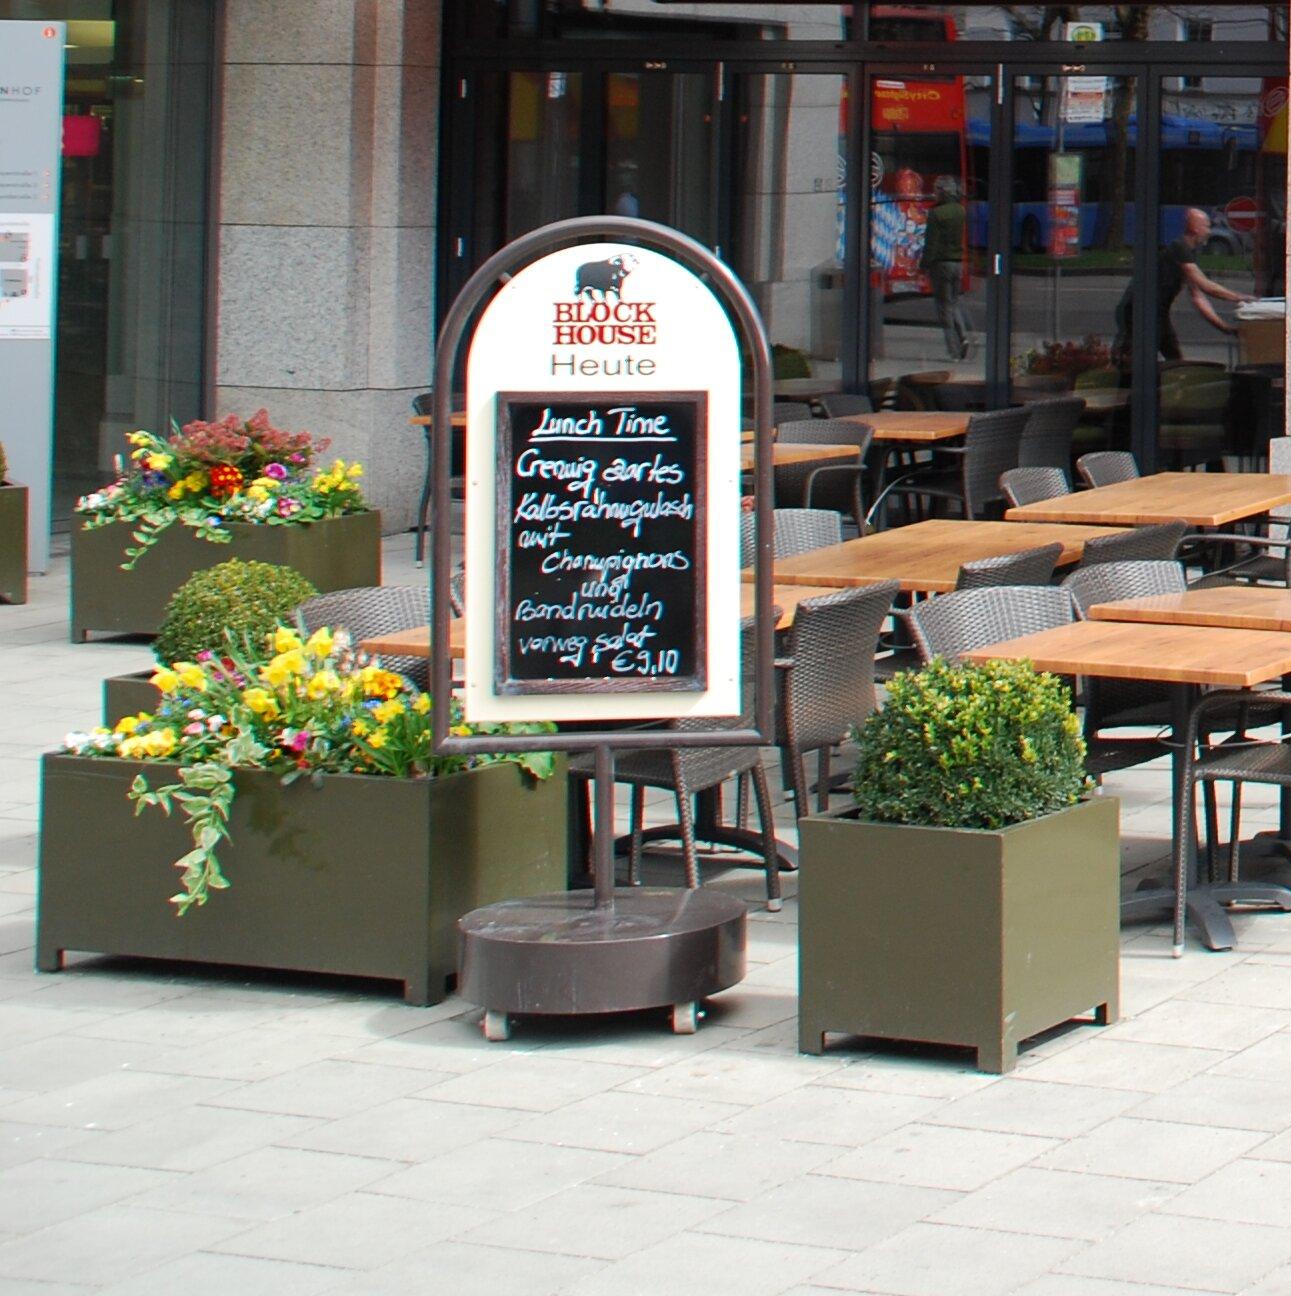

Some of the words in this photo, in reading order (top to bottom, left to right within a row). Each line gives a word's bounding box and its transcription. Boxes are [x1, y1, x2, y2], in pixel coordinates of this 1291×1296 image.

[553, 302, 656, 323] BLOCK
[553, 324, 656, 345] HOUSE
[550, 354, 656, 376] Heute
[531, 408, 602, 437] Lunch
[607, 407, 671, 435] Time
